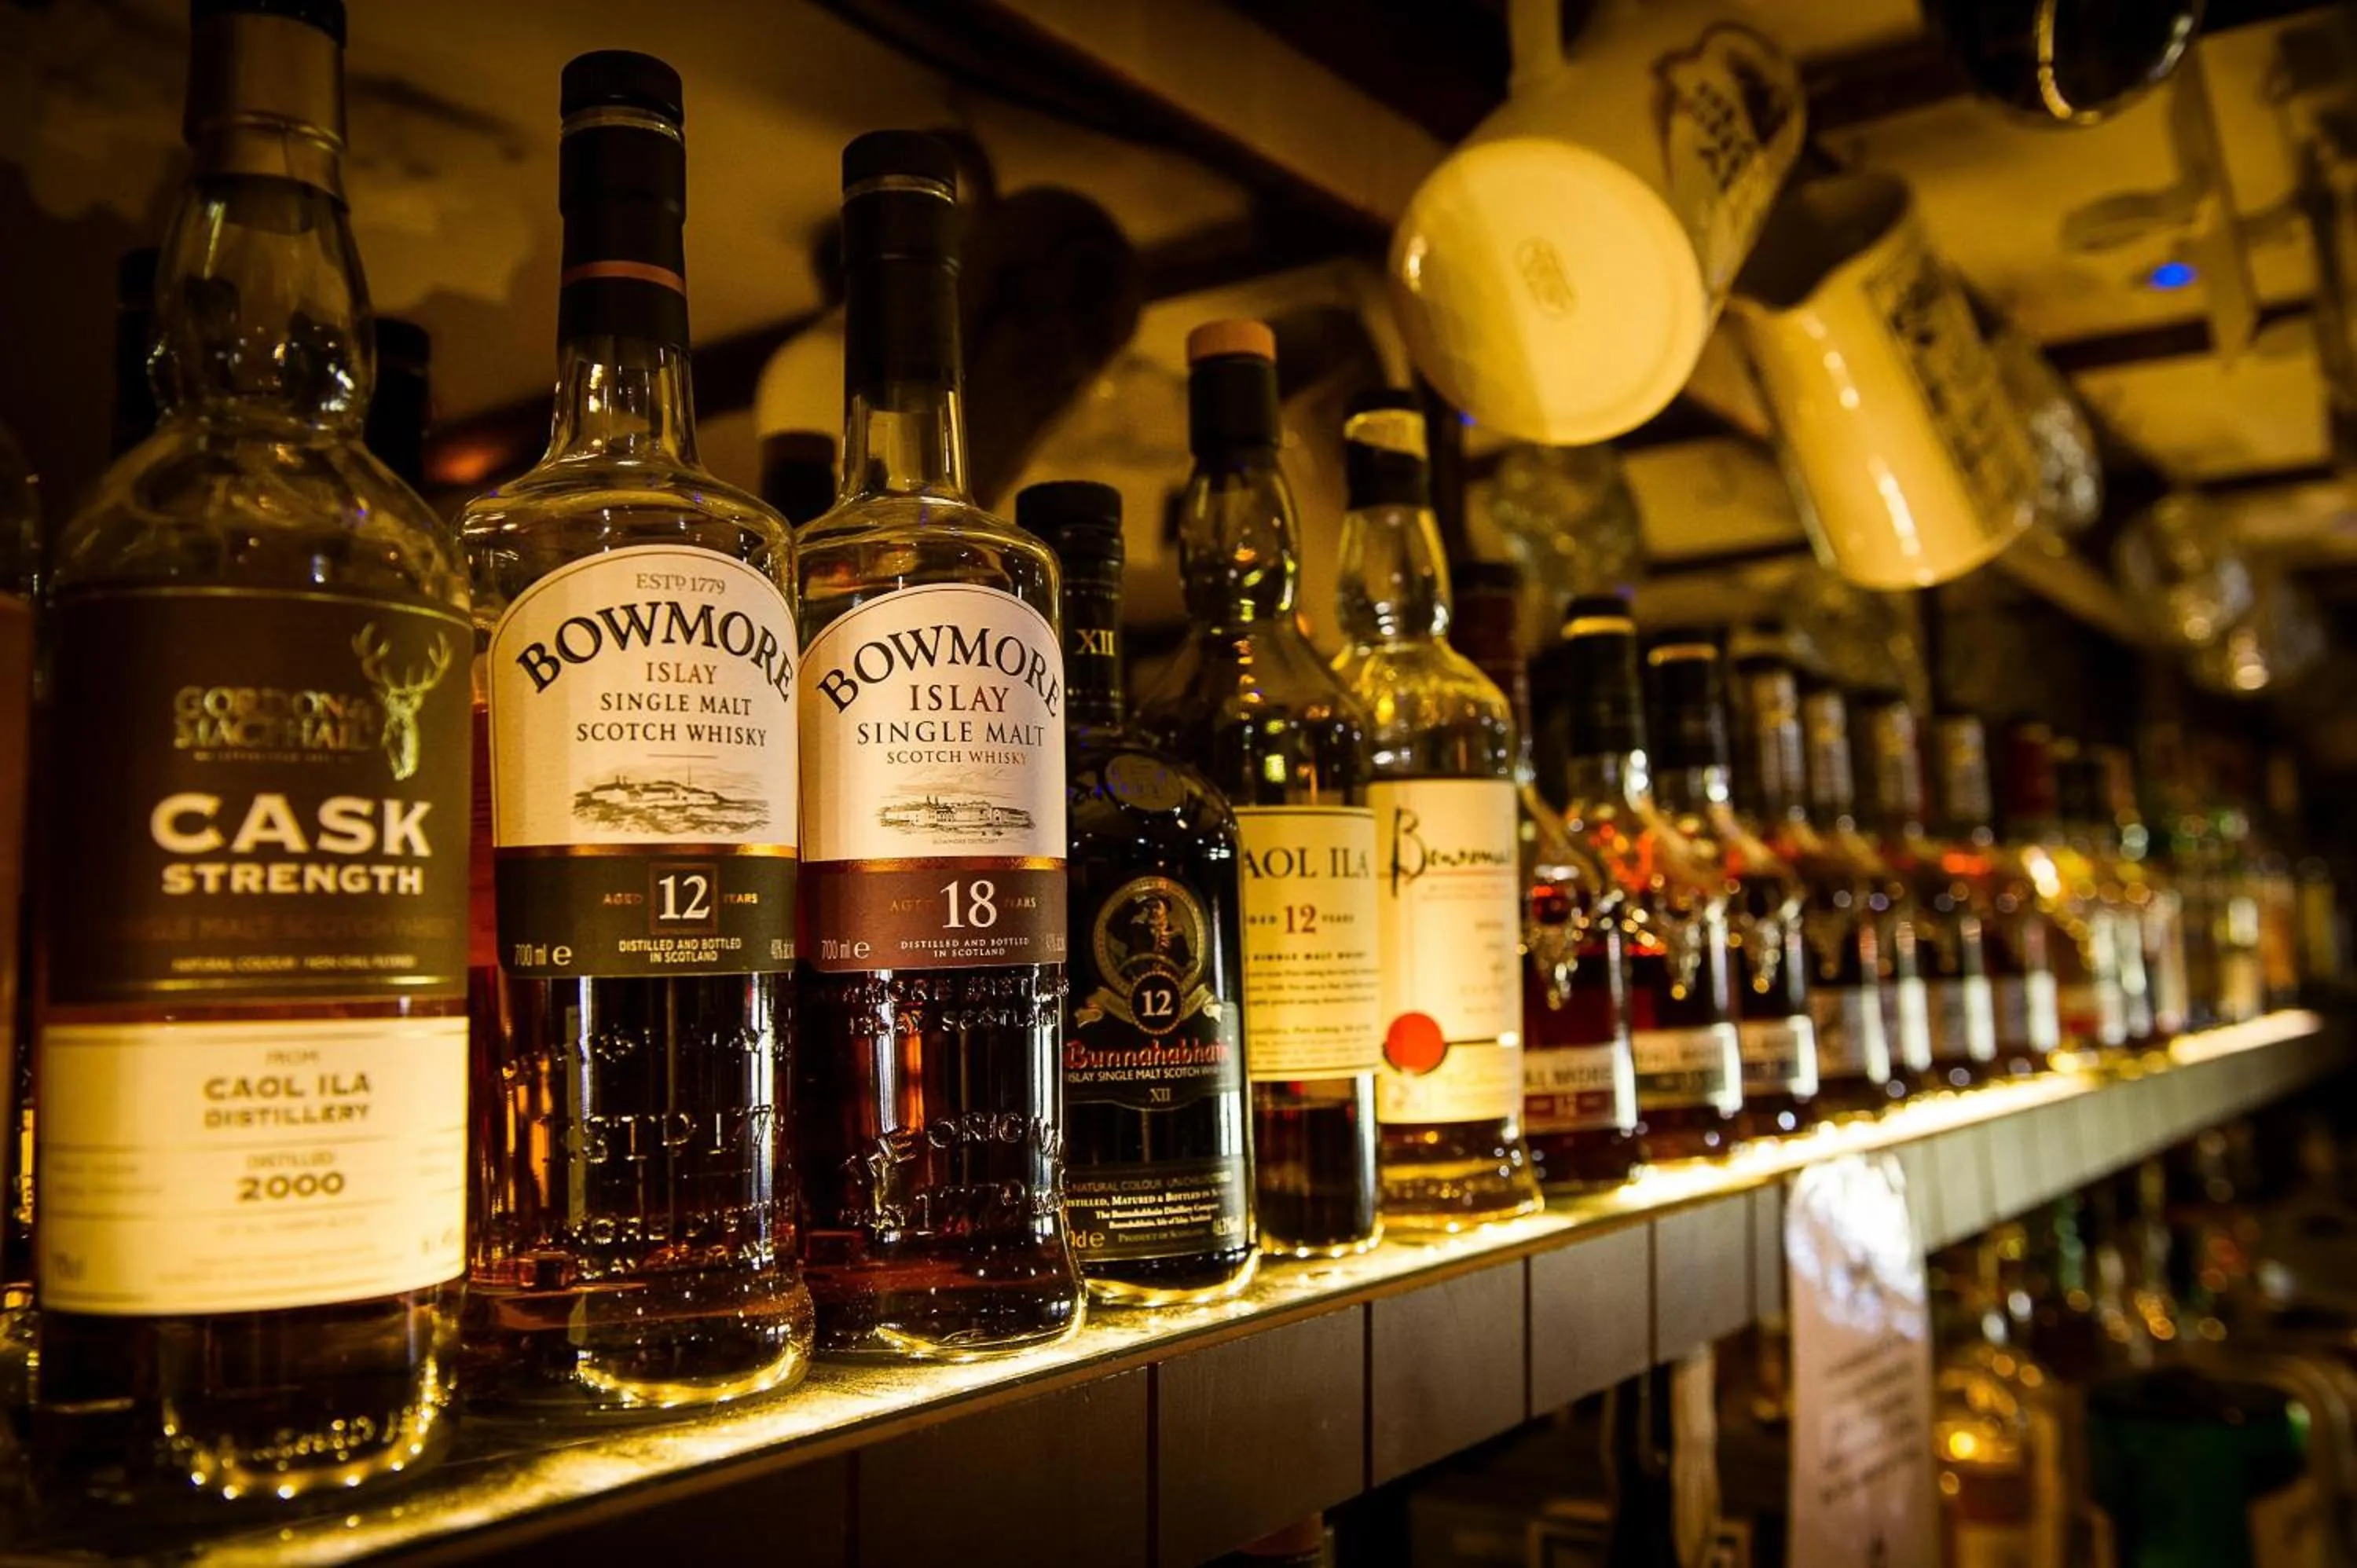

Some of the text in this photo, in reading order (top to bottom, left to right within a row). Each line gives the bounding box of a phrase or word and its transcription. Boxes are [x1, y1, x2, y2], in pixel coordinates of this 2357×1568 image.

[689, 575, 726, 595] 1779
[516, 601, 794, 702] BOWMORE
[1075, 629, 1115, 657] XII
[646, 662, 718, 685] ISLAY
[816, 625, 1062, 717] BOWMORE
[599, 692, 753, 716] SINGLE MALT
[909, 683, 1010, 713] ISLAY
[577, 722, 768, 748] SCOTCH WHISKY
[857, 720, 1046, 748] SINGLE MALT
[886, 749, 1028, 765] SCOTCH WHISKY
[150, 793, 433, 857] CASK
[1243, 846, 1370, 880] AOL ILA
[162, 863, 424, 895] STRENGTH
[603, 874, 758, 920] AGED 12 YEARS
[940, 879, 998, 929] 18
[1285, 903, 1318, 934] 12
[618, 937, 742, 952] DISTILLED AND BOTTLED
[650, 949, 718, 963] IN SCOTLAND
[900, 936, 1030, 951] DISTILLED AND BOTTLED
[933, 947, 1006, 958] IN SCOTLAND
[1142, 989, 1175, 1017] 12
[203, 1072, 371, 1101] CAOL ILA
[1068, 1072, 1095, 1084] ISLAY
[1098, 1069, 1134, 1081] SINGLE
[1135, 1068, 1161, 1080] MALT
[1164, 1067, 1200, 1079] SCOTCH
[1149, 1088, 1171, 1104] XII
[203, 1103, 370, 1130] DISTILLERY
[236, 1171, 346, 1203] 2000
[1072, 1181, 1120, 1193] NATURAL
[1121, 1179, 1163, 1191] COLOUR
[1065, 1197, 1110, 1208] ISTILLED,
[1112, 1195, 1156, 1206] MATURED
[1165, 1191, 1200, 1203] BOTTLED
[1095, 1211, 1110, 1220] The
[1118, 1231, 1158, 1244] PRODUCT
